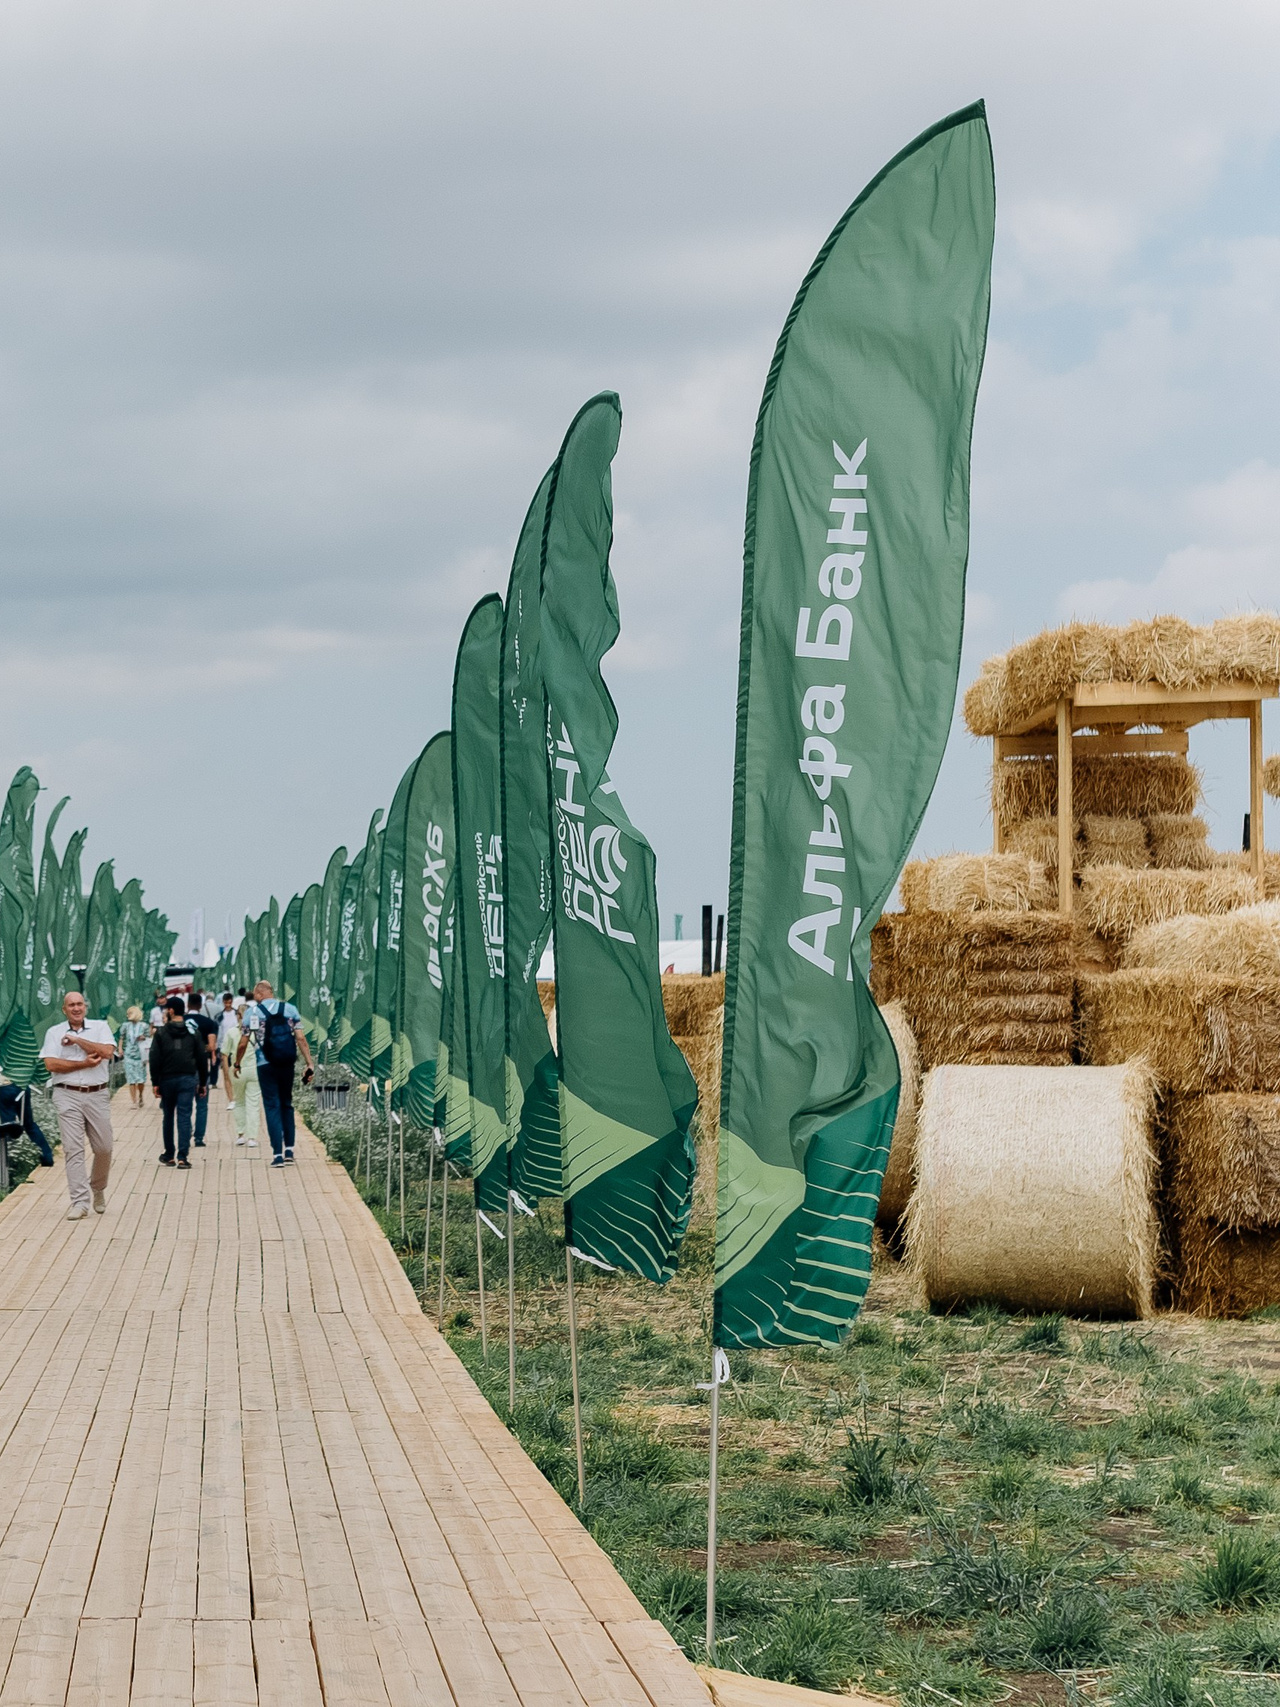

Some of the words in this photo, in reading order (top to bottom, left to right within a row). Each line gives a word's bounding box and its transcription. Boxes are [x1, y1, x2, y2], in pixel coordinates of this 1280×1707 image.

[795, 437, 868, 661] Банк
[485, 834, 505, 979] ДЕНЬ
[787, 684, 853, 977] Альфа
